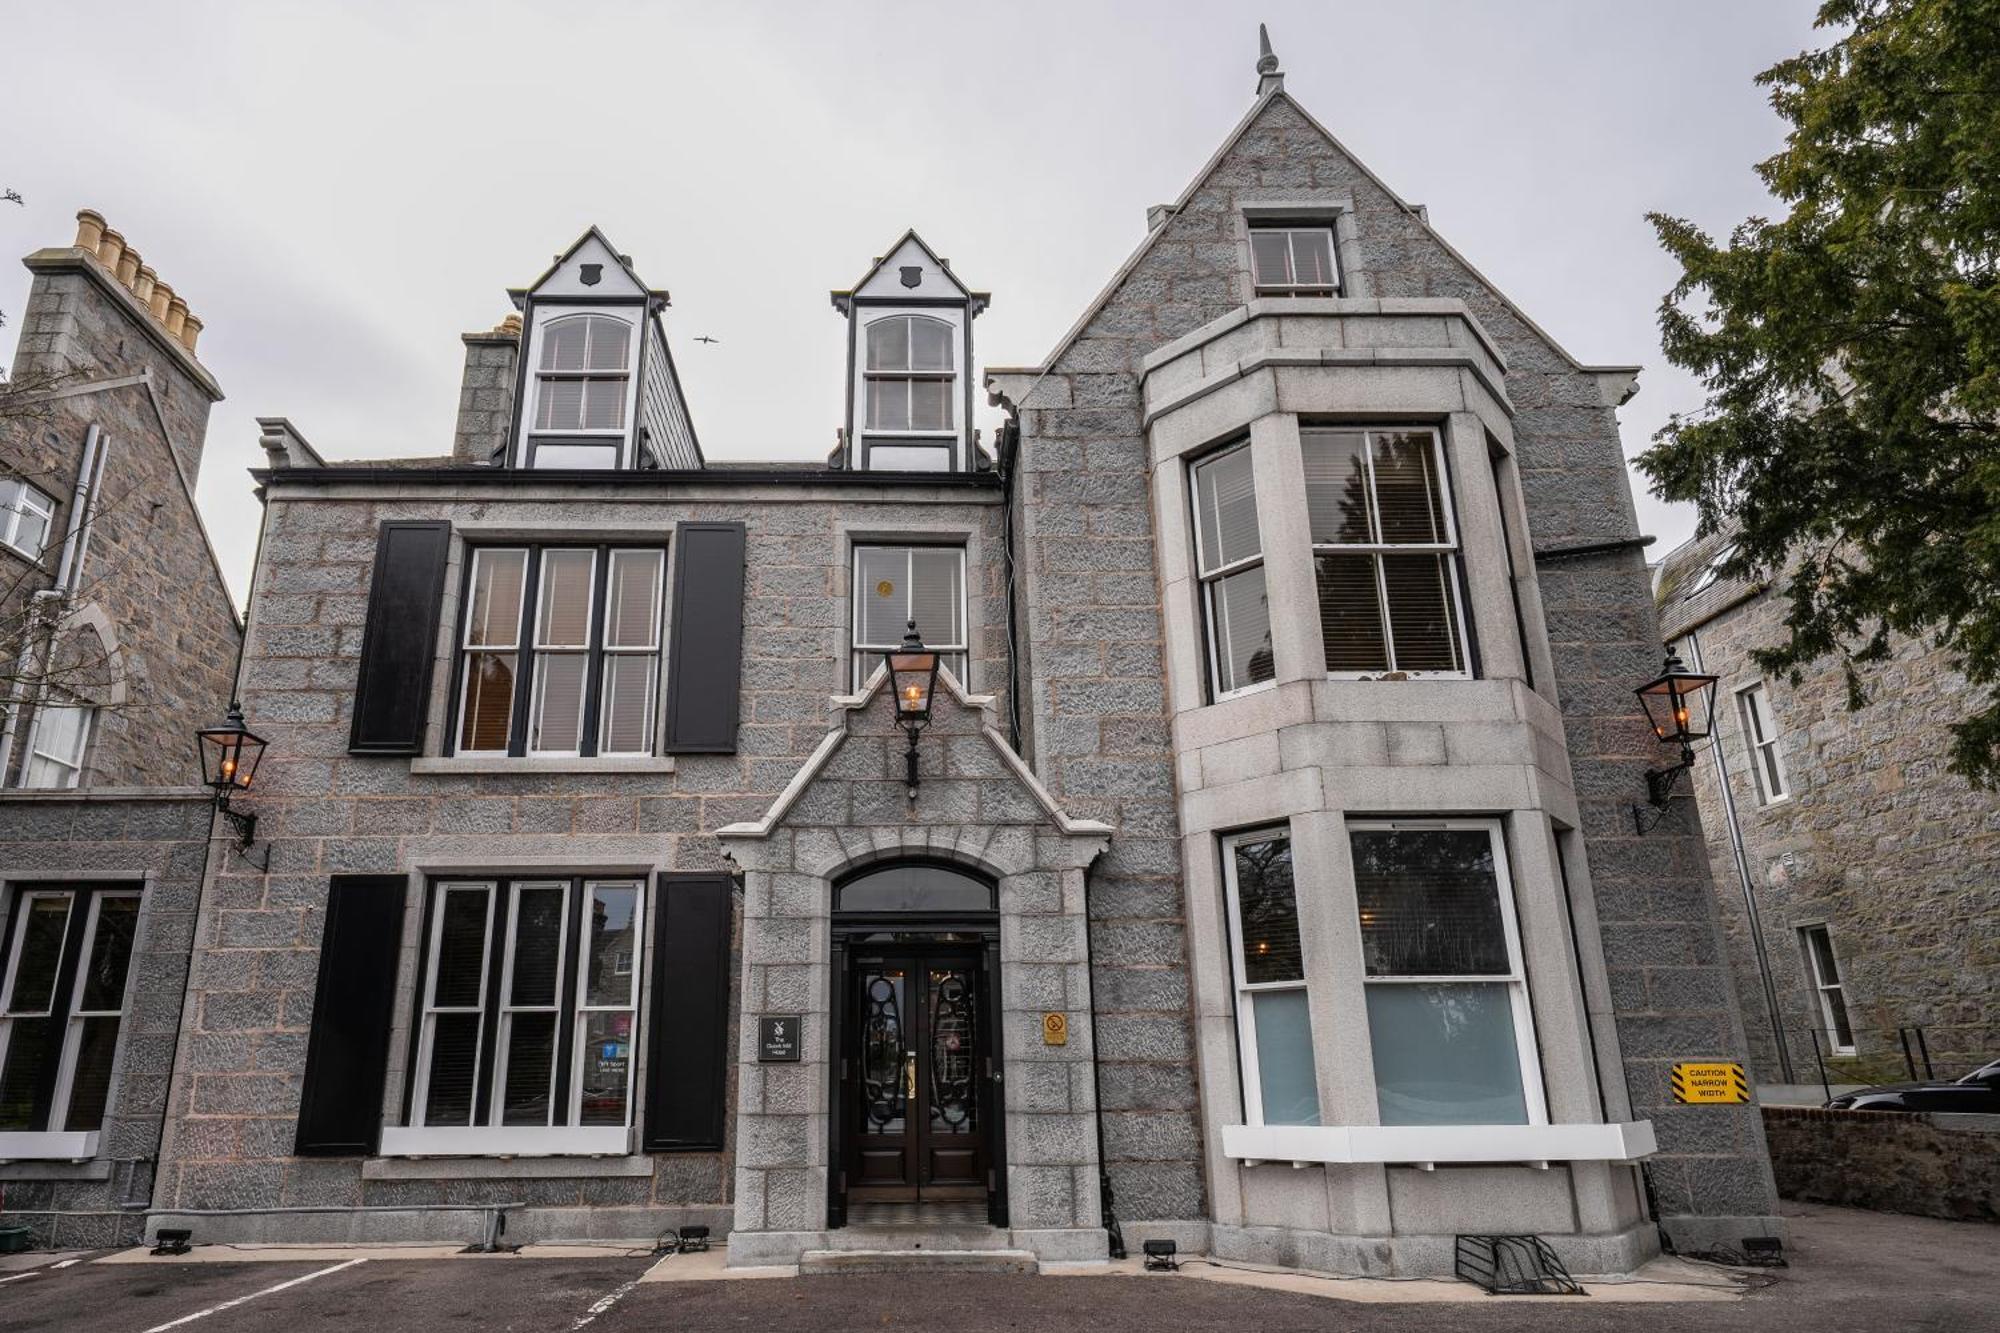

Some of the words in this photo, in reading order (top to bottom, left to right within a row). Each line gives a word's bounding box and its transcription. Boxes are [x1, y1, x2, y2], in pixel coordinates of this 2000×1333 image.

[1689, 1069, 1727, 1077] CAUTION
[1691, 1079, 1728, 1087] NARROW
[1698, 1089, 1726, 1097] WIDTH
